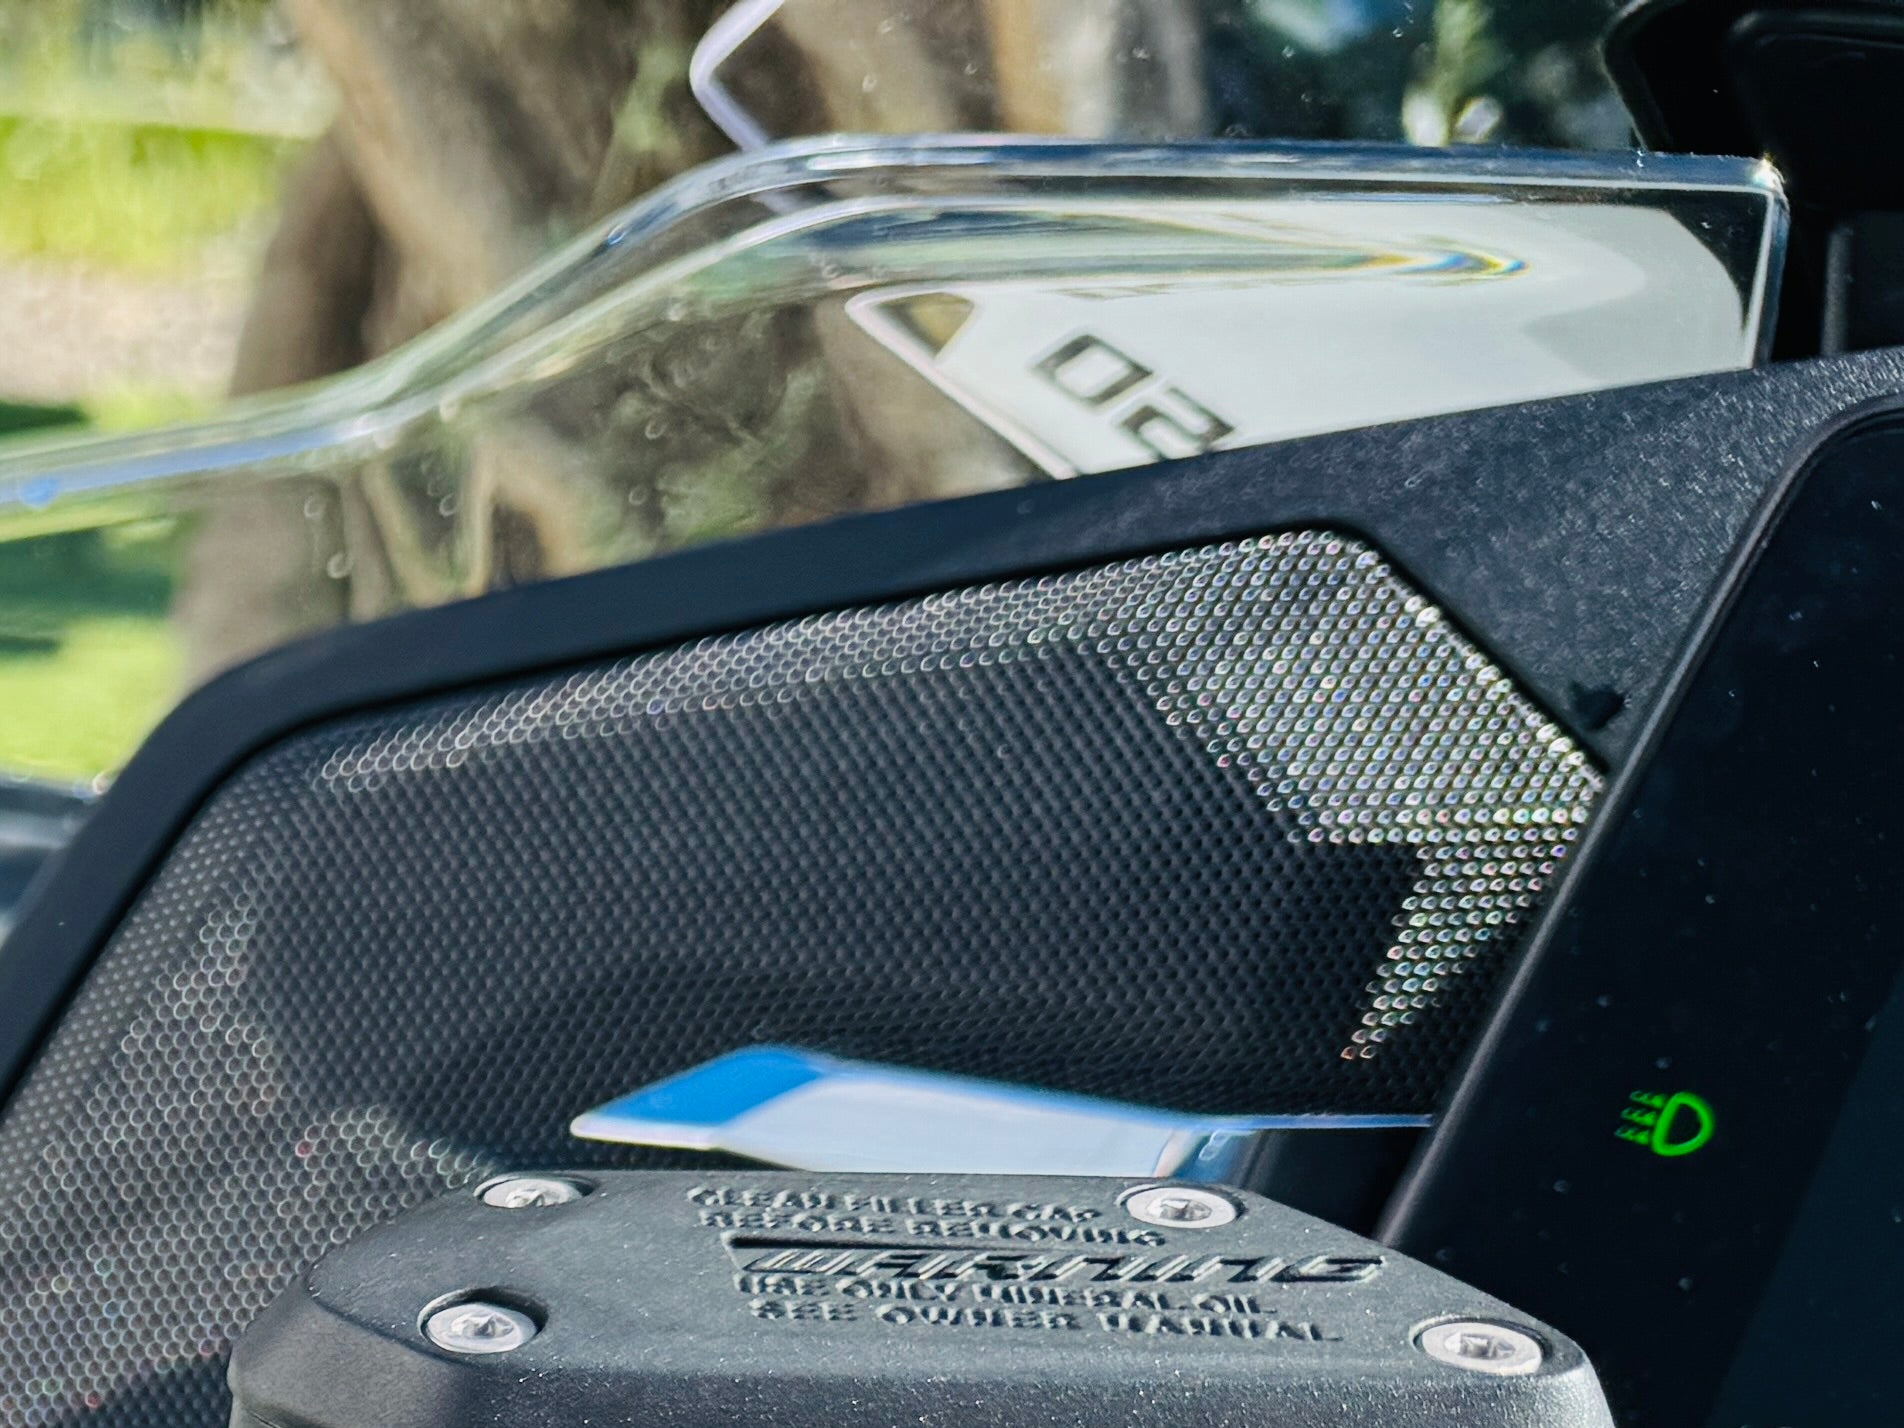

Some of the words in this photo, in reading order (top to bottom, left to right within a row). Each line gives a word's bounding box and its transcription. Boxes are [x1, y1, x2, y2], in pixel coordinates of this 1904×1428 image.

[698, 1209, 895, 1233] BEFORE
[905, 1218, 1165, 1247] REMOVING
[1006, 1202, 1101, 1224] CAP
[742, 1250, 1386, 1283] WARNING
[733, 1273, 830, 1297] USE
[836, 1278, 962, 1302] ONLY
[972, 1282, 1188, 1312] MINERAL
[1191, 1293, 1278, 1315] OIL
[748, 1299, 859, 1321] SEE
[876, 1304, 1084, 1331] OWNER
[1096, 1312, 1344, 1341] MANUAL
